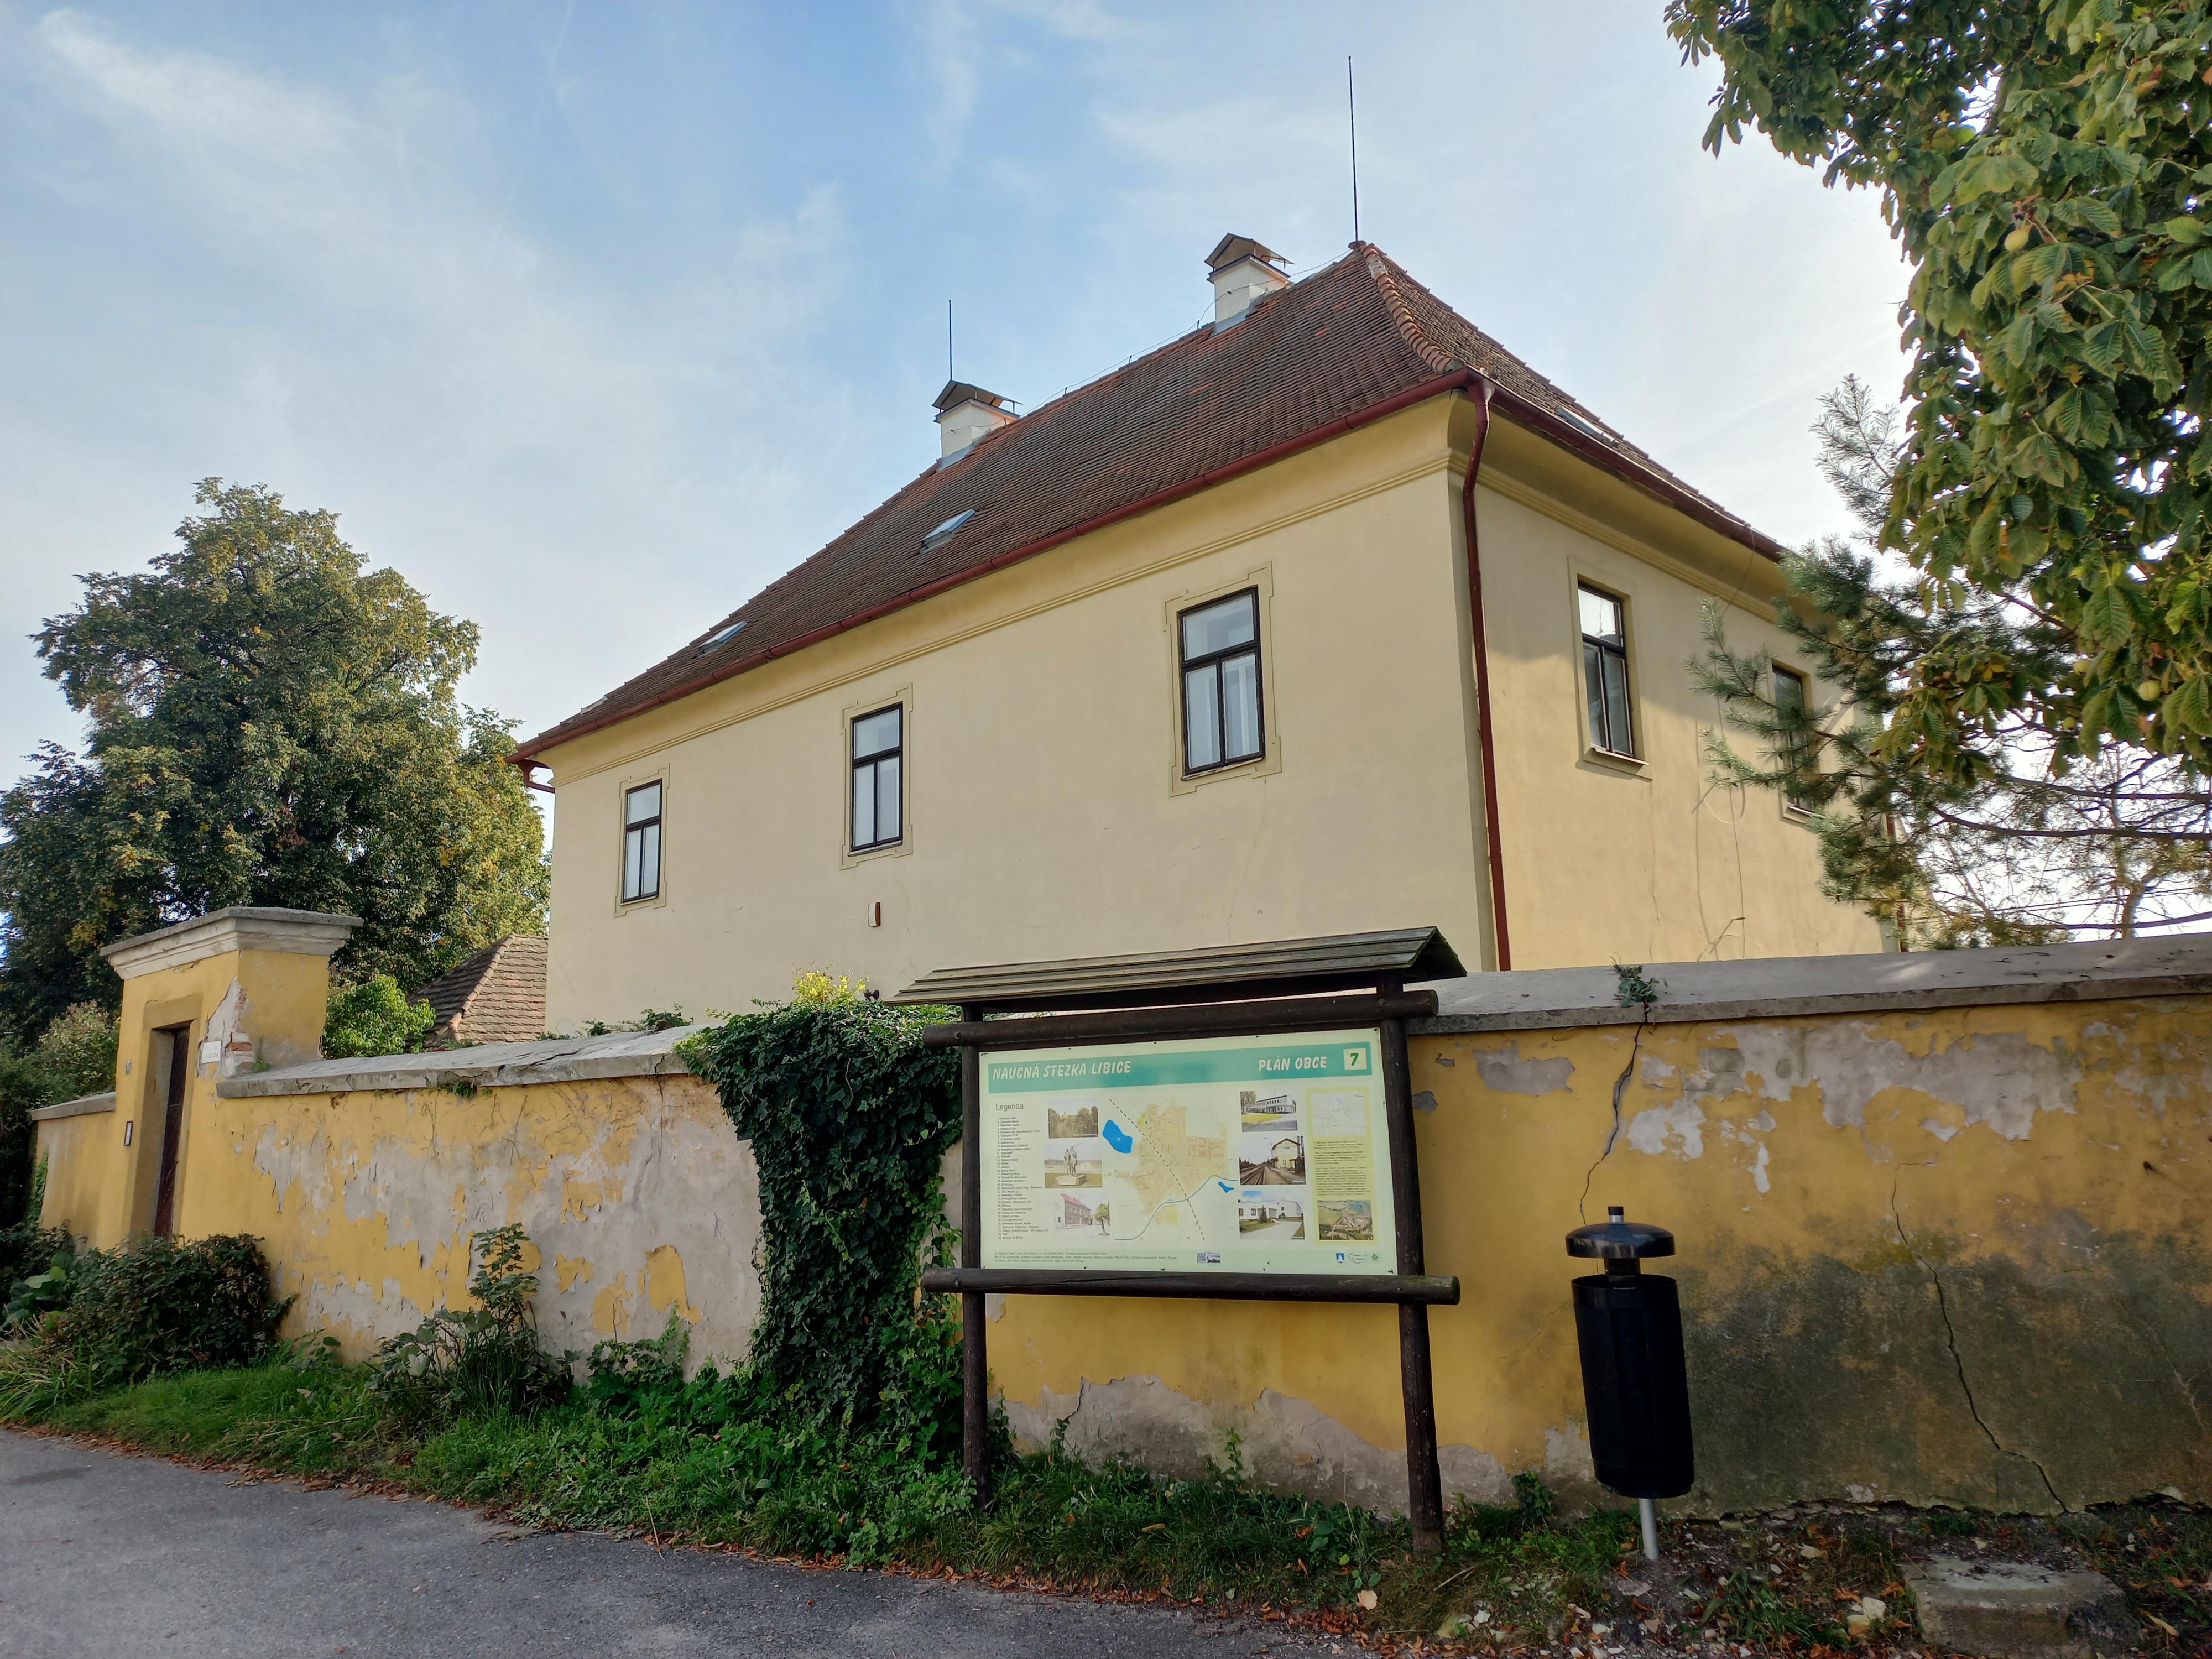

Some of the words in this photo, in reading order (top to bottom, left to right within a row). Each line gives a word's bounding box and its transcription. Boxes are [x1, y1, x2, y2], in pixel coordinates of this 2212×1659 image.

[1258, 1056, 1291, 1071] PLÁN
[1295, 1056, 1328, 1070] OBCE
[1350, 1053, 1359, 1066] 7
[993, 1063, 1039, 1080] NAUČNÁ
[1044, 1063, 1086, 1078] STEZKA
[1091, 1061, 1131, 1075] LIBICE
[995, 1103, 1024, 1112] Legenda
